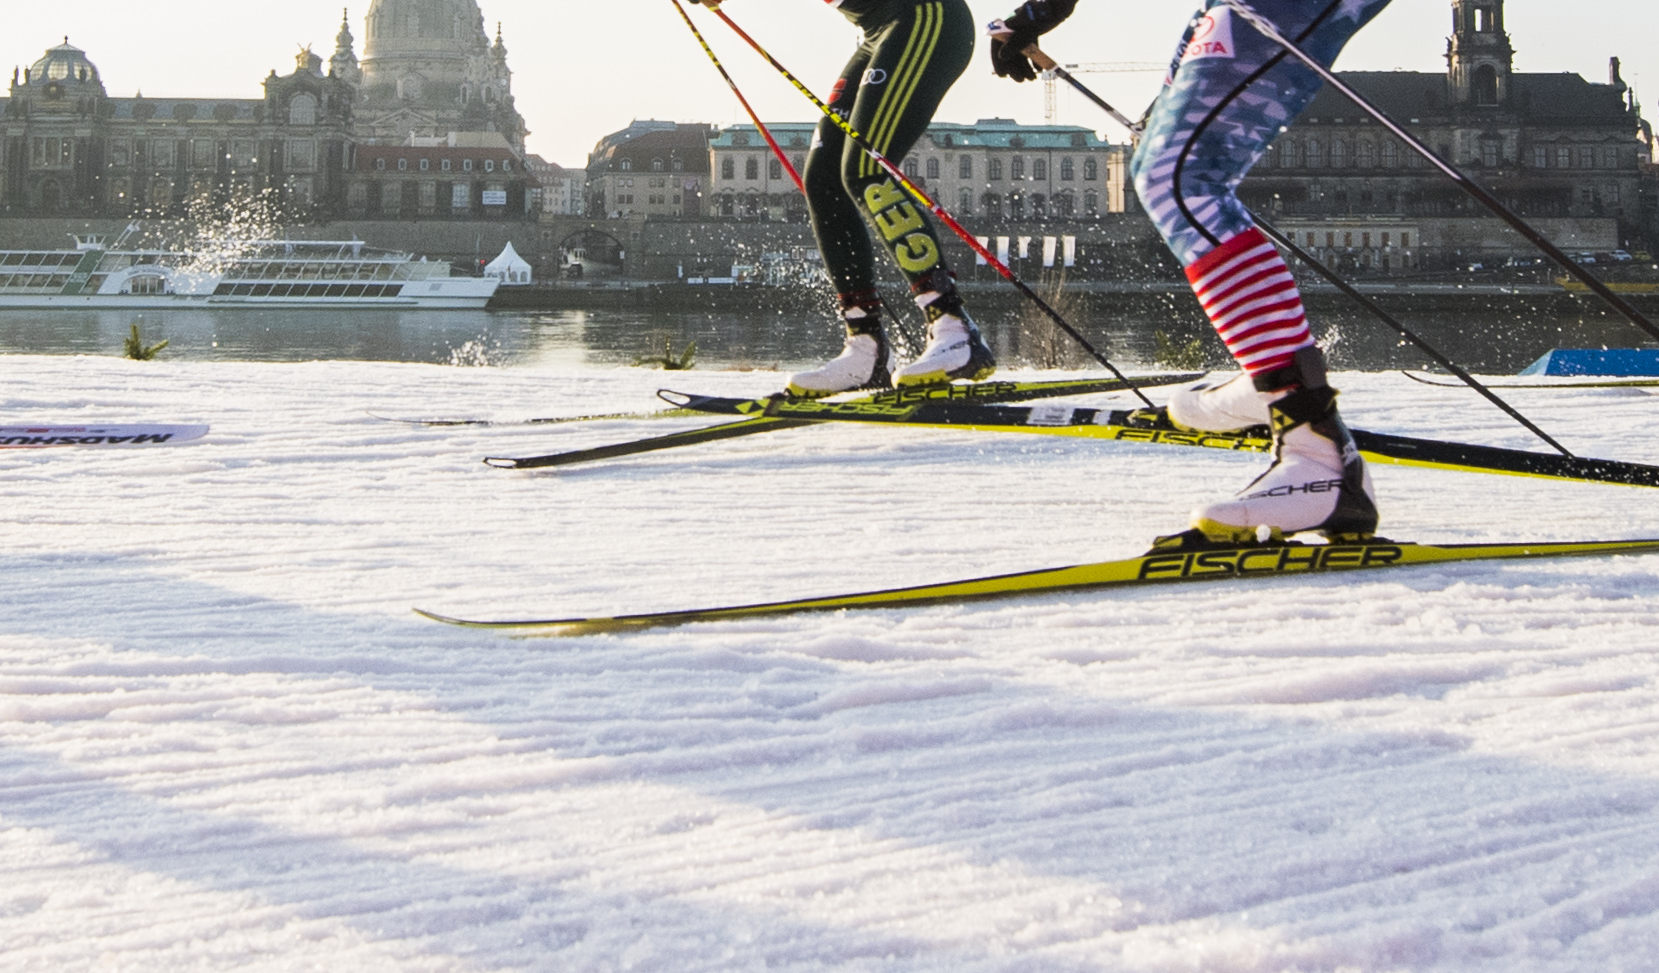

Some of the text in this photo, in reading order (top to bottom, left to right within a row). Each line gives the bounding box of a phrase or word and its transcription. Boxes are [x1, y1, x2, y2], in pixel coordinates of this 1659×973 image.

[864, 177, 940, 272] GER
[1115, 428, 1273, 454] FISCH
[1137, 545, 1403, 579] FISCHER
